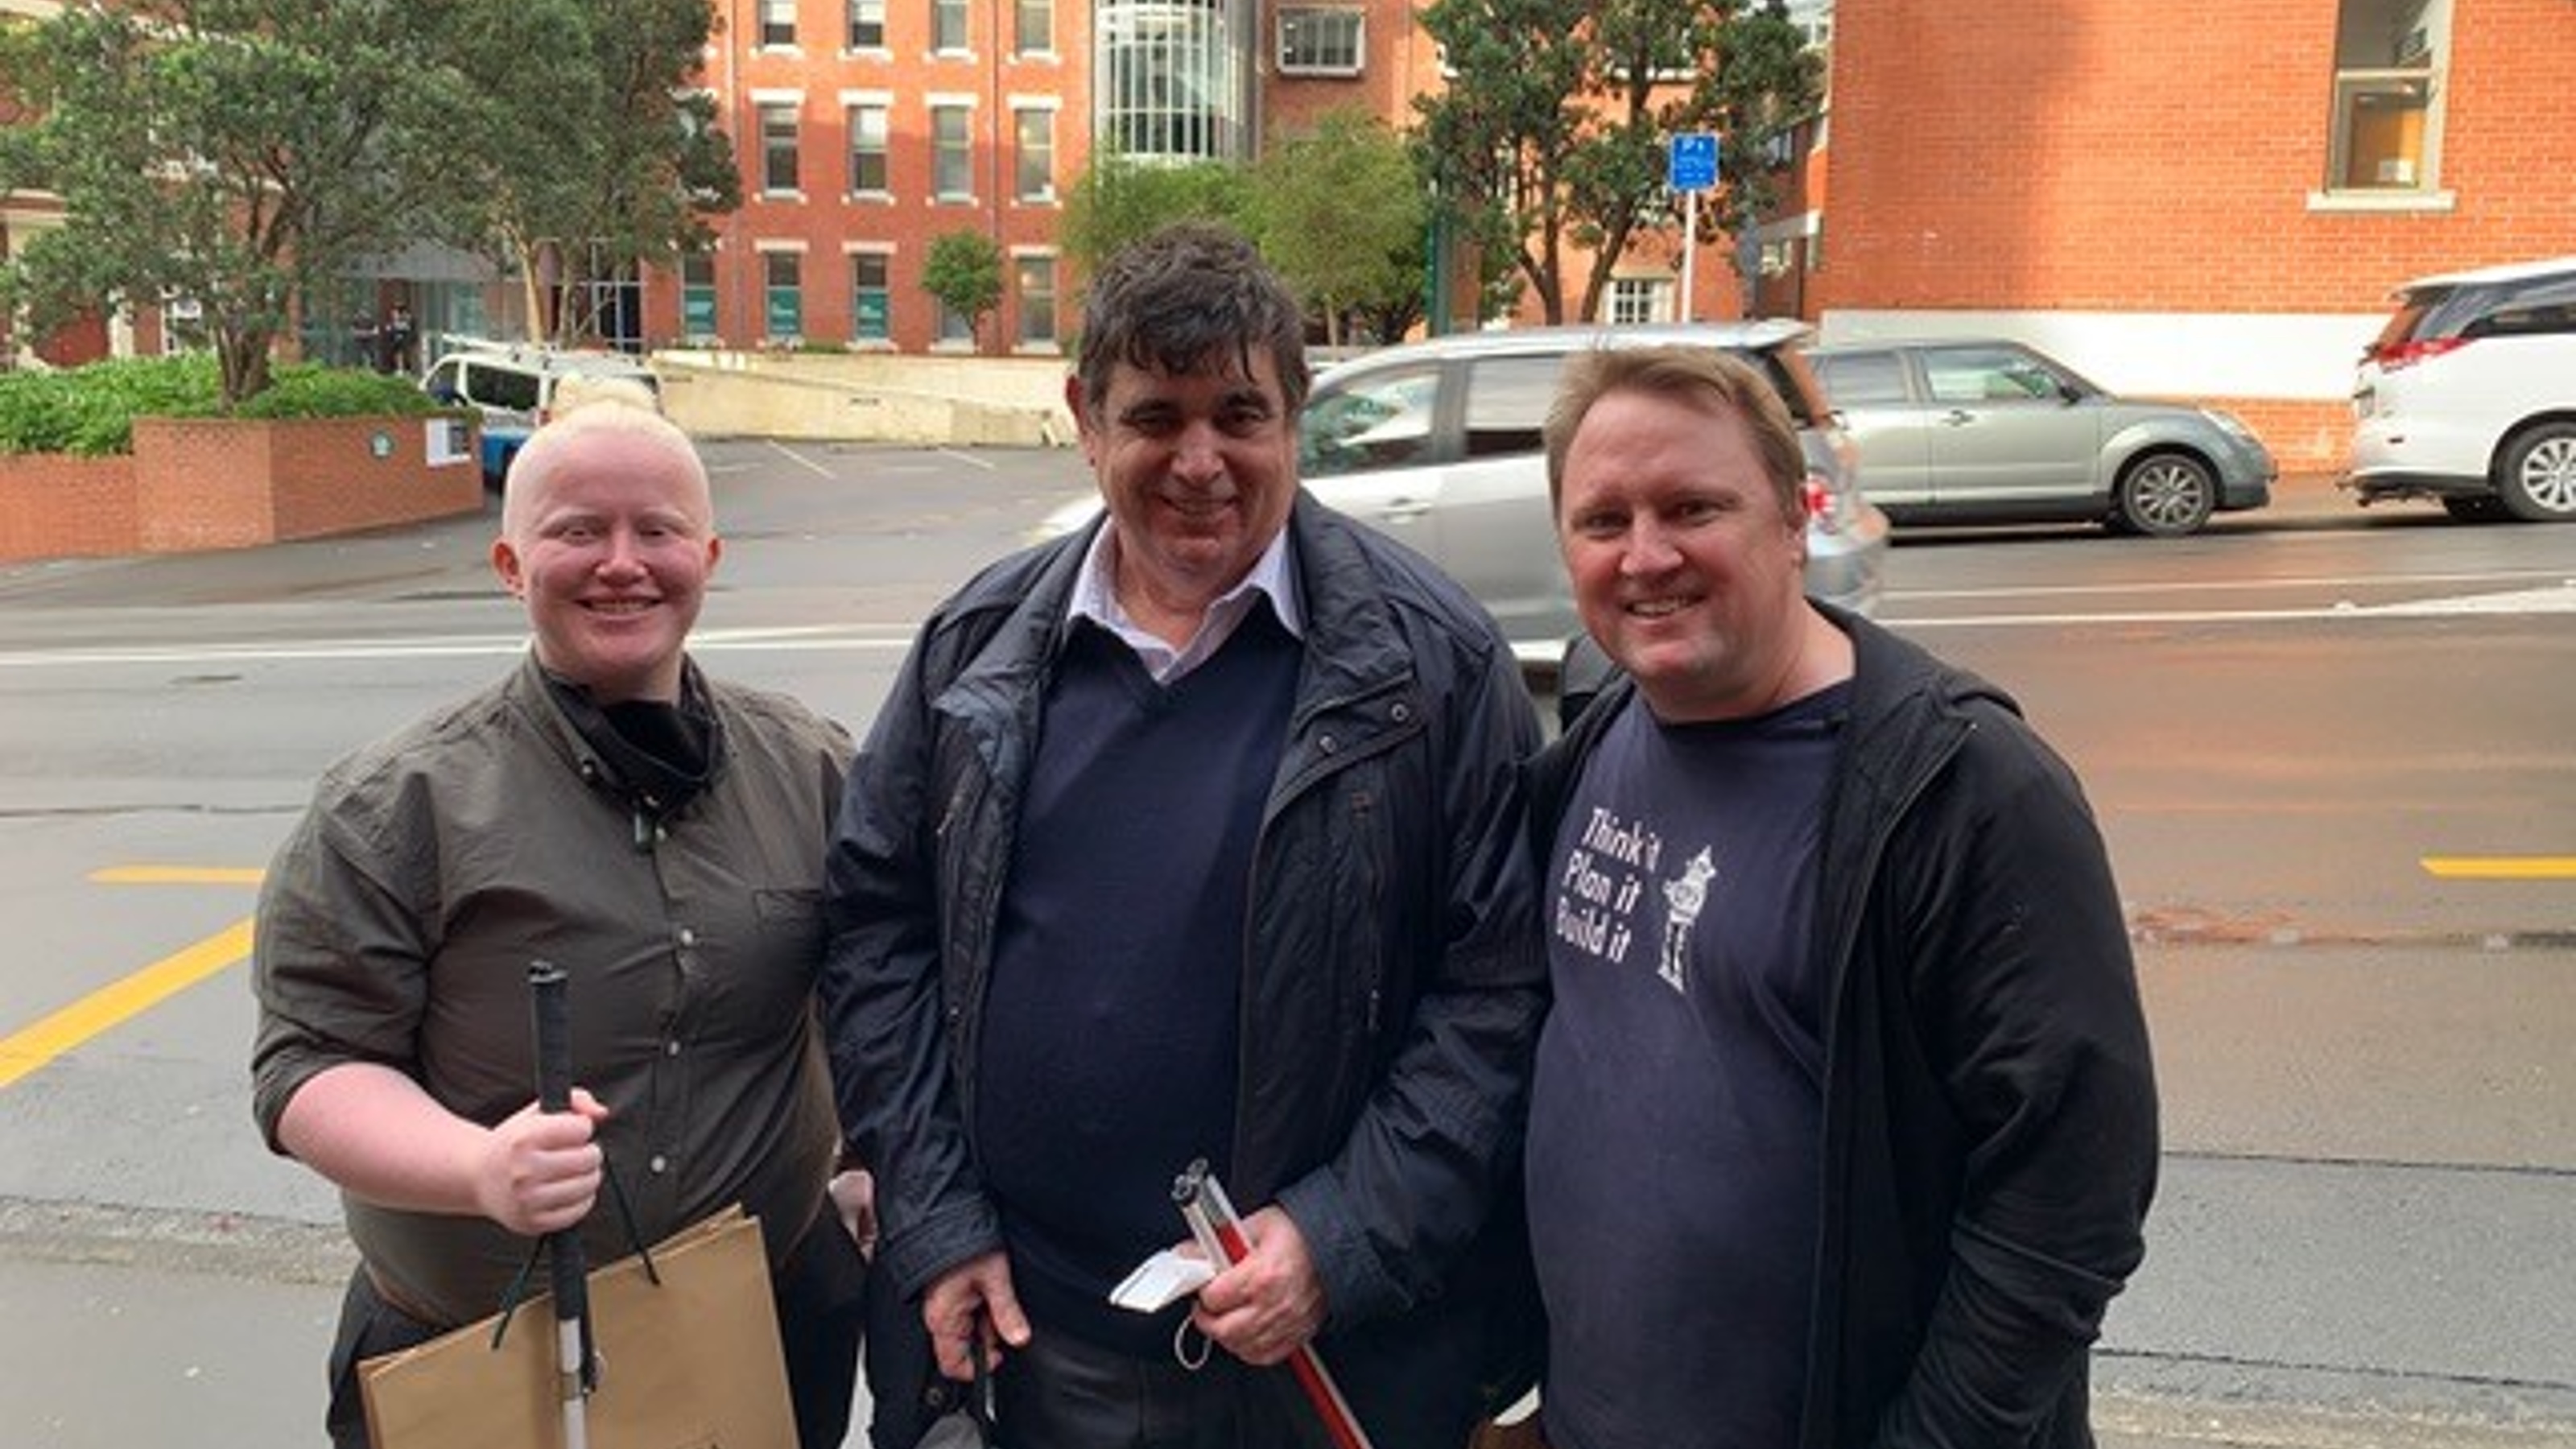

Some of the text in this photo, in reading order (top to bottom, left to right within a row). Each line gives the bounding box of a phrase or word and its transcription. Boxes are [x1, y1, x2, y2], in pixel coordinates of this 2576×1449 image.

[1582, 807, 1643, 865] Think
[1562, 850, 1641, 914] Plan it
[1557, 897, 1632, 963] Build it
